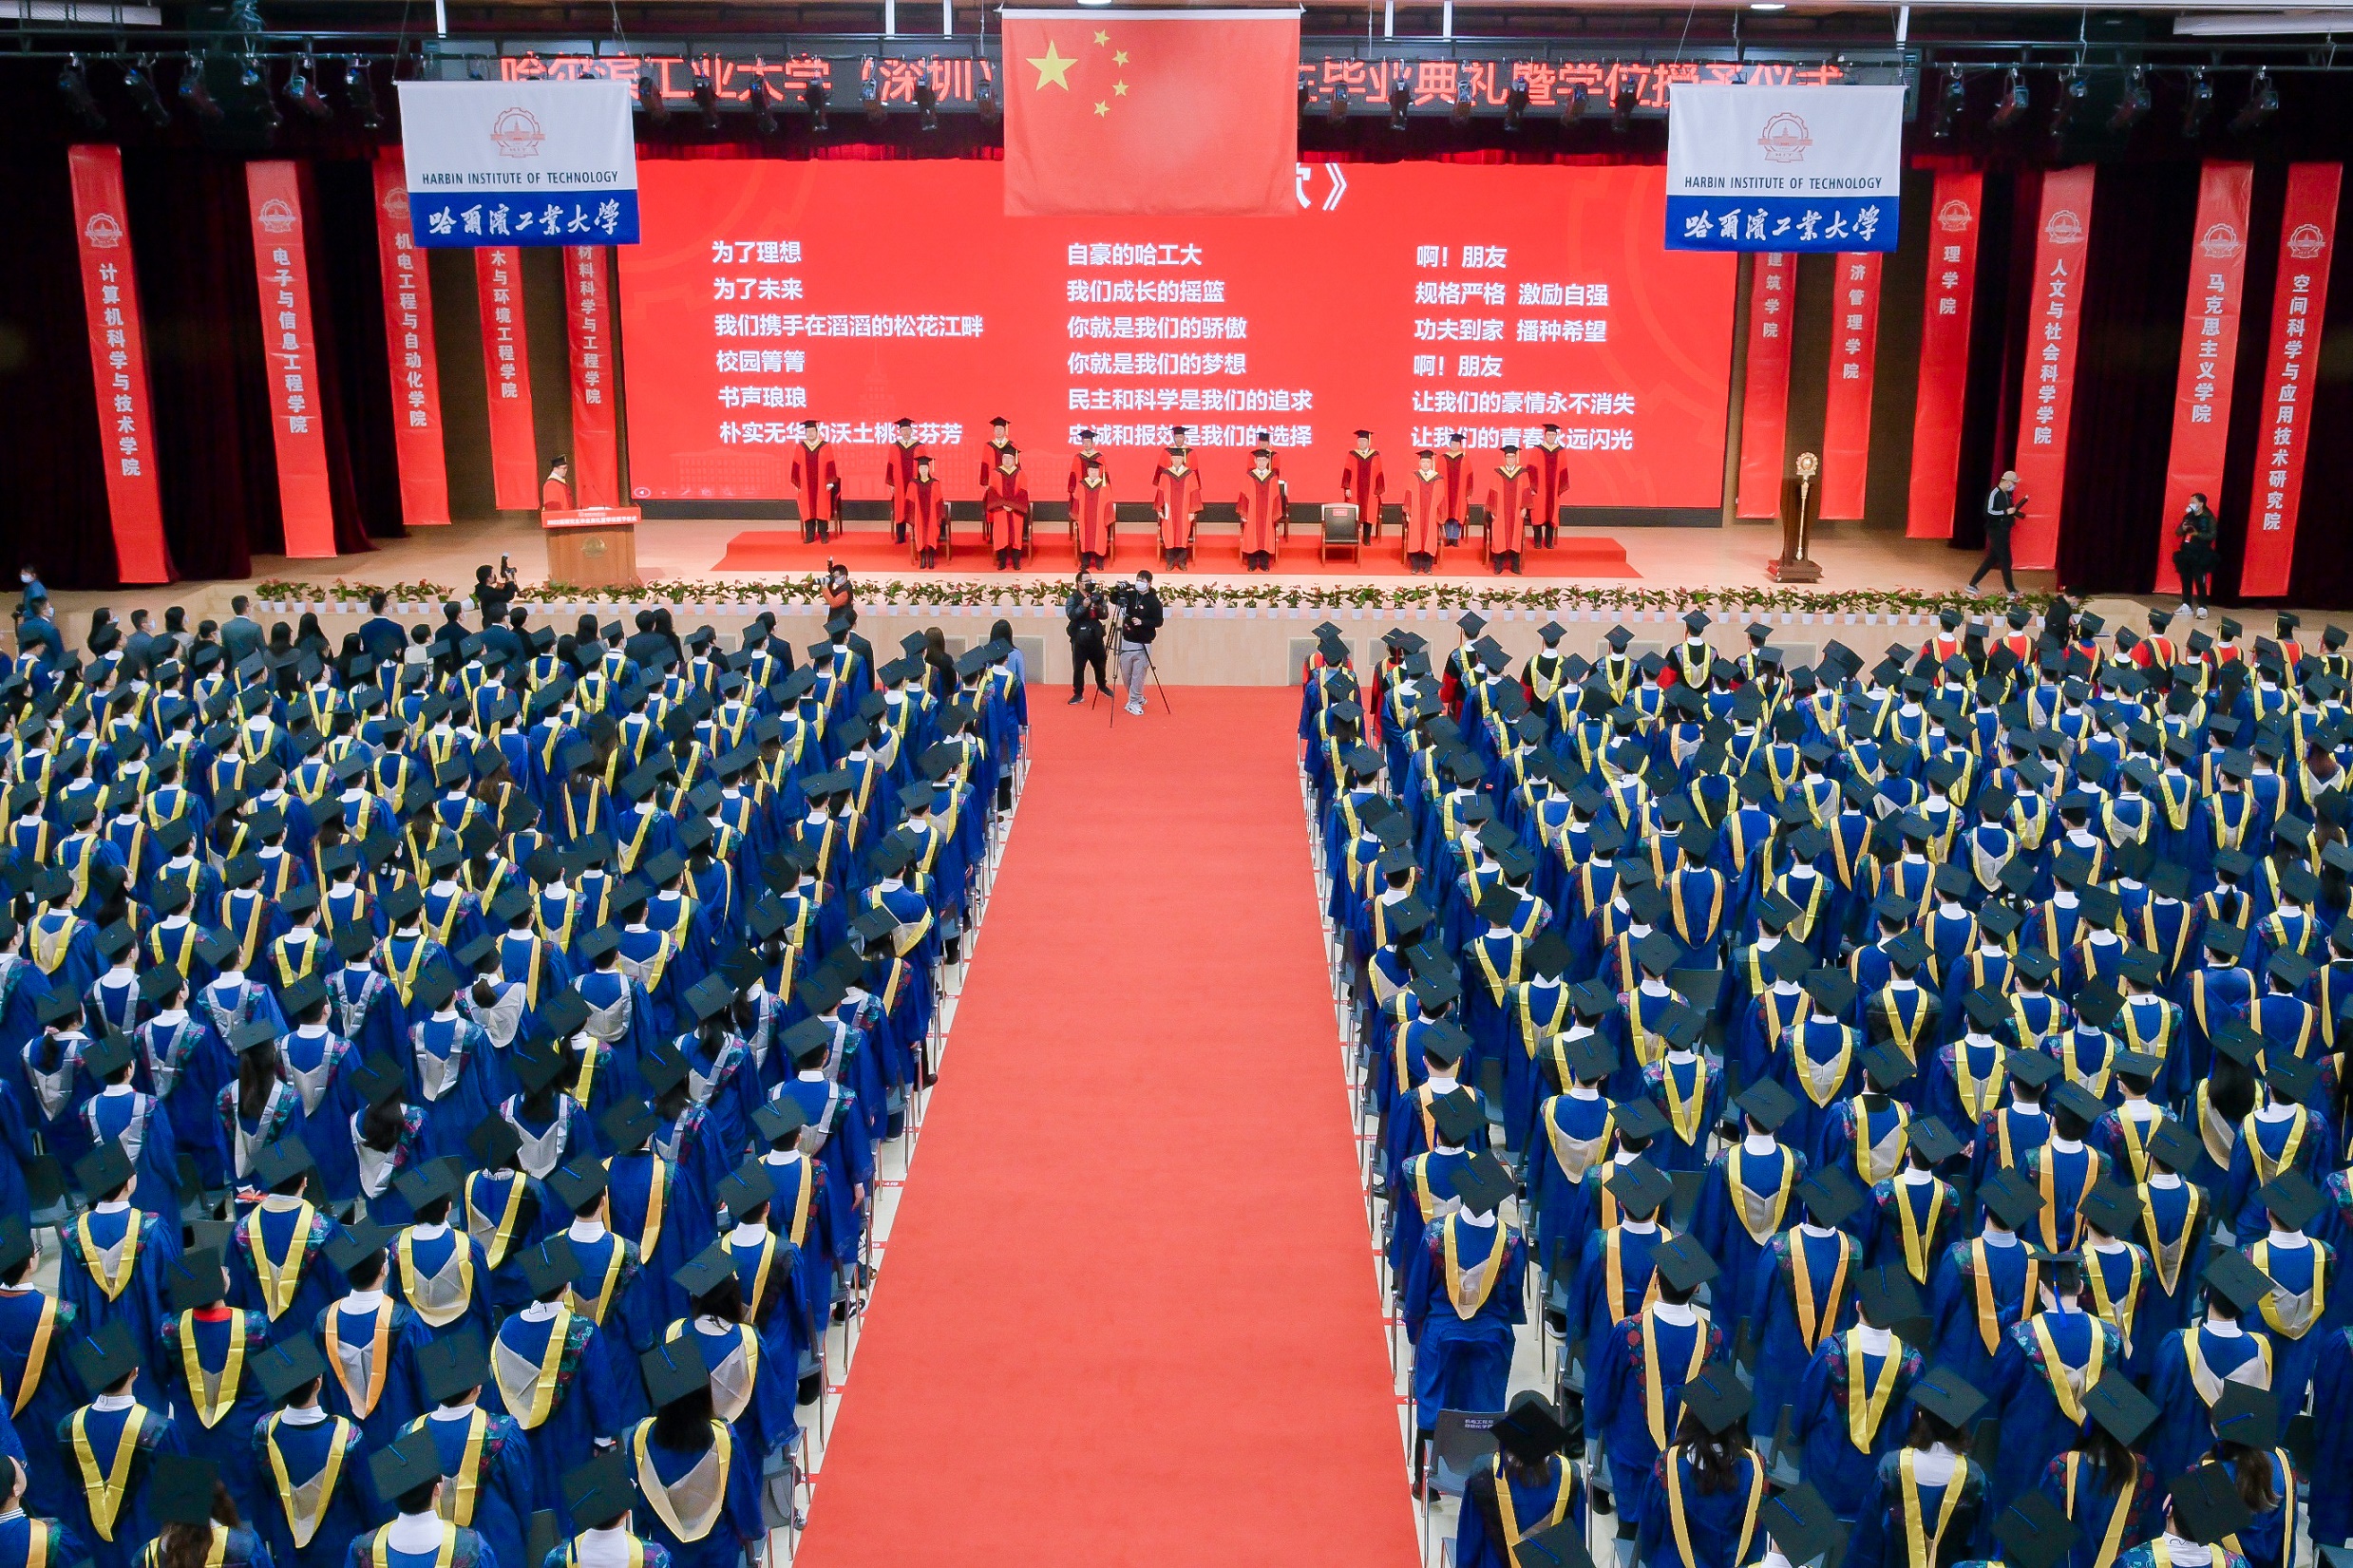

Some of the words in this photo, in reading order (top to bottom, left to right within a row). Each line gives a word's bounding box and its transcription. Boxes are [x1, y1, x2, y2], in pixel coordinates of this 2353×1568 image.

[422, 172, 464, 185] HARBIN
[467, 171, 522, 184] INSTITUTE
[527, 172, 541, 184] OF
[547, 170, 618, 184] TECHNOLOGY
[1684, 176, 1725, 189] HARBIN
[1730, 176, 1785, 190] INSTITUTE
[1790, 177, 1804, 190] OF
[1809, 177, 1883, 190] TECHNOLOGY
[712, 240, 802, 263] 为了理想
[1068, 242, 1203, 266] 自豪的哈工大
[713, 277, 804, 300] 为了未来
[1067, 279, 1225, 303] 我们成长的摇篮
[1939, 245, 1962, 315] 理学院
[1415, 281, 1506, 306] 规格严格
[1518, 282, 1608, 307] 激励自强
[1762, 252, 1783, 338] 建筑学院
[578, 246, 602, 405] 材料科学与工程学院
[714, 313, 984, 337] 我们携手在滔滔的松花江畔
[1067, 315, 1247, 339] 你就是我们的骄傲
[1842, 253, 1868, 380] 济管理学院
[273, 247, 308, 434] 电子与信息工程学院
[394, 233, 427, 427] 机电工程与自动化学院
[1414, 318, 1505, 341] 功夫到家
[1516, 319, 1606, 343] 播种希望
[2034, 257, 2069, 445] 人文与社会科学学院
[2192, 273, 2227, 424] 马克思主义学院
[99, 262, 142, 477] 计算机科学与技术学院
[1067, 351, 1246, 375] 你就是我们的梦想
[717, 386, 807, 408] 书声琅琅
[1068, 387, 1314, 411] 民主和科学是我们的追求
[1413, 390, 1635, 415] 让我们的豪情永不消失
[2263, 274, 2311, 532] 空间科学与应用技术研究院
